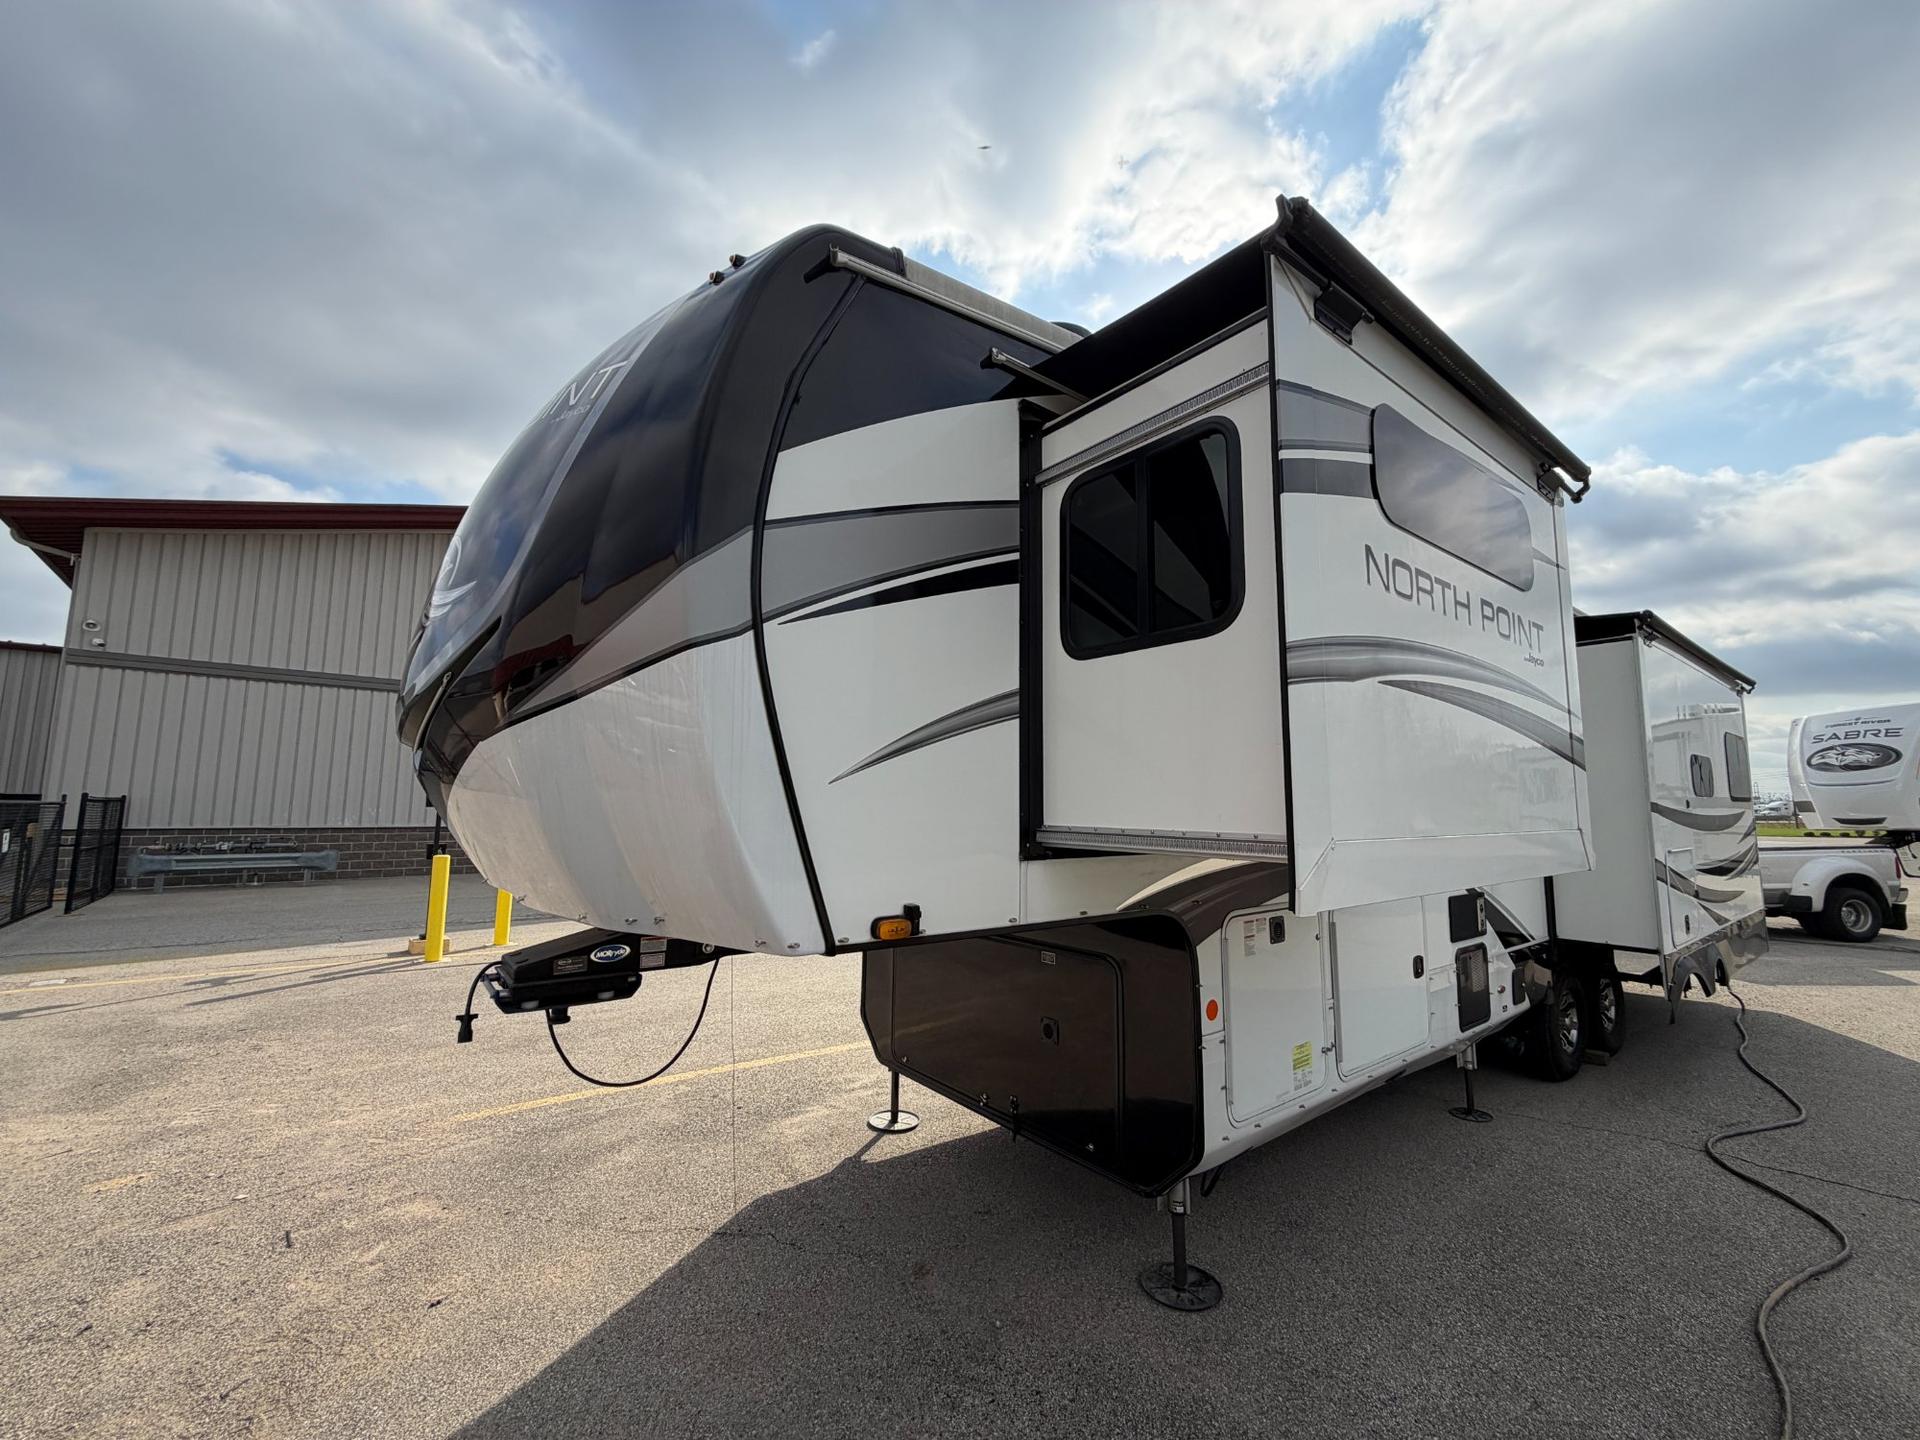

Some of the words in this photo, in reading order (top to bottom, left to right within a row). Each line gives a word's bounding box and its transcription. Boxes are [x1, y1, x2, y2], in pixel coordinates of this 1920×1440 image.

[1364, 543, 1472, 626] NORTH
[1480, 597, 1545, 653] POINT
[1529, 652, 1545, 667] Jayco
[1812, 727, 1904, 744] SABRE
